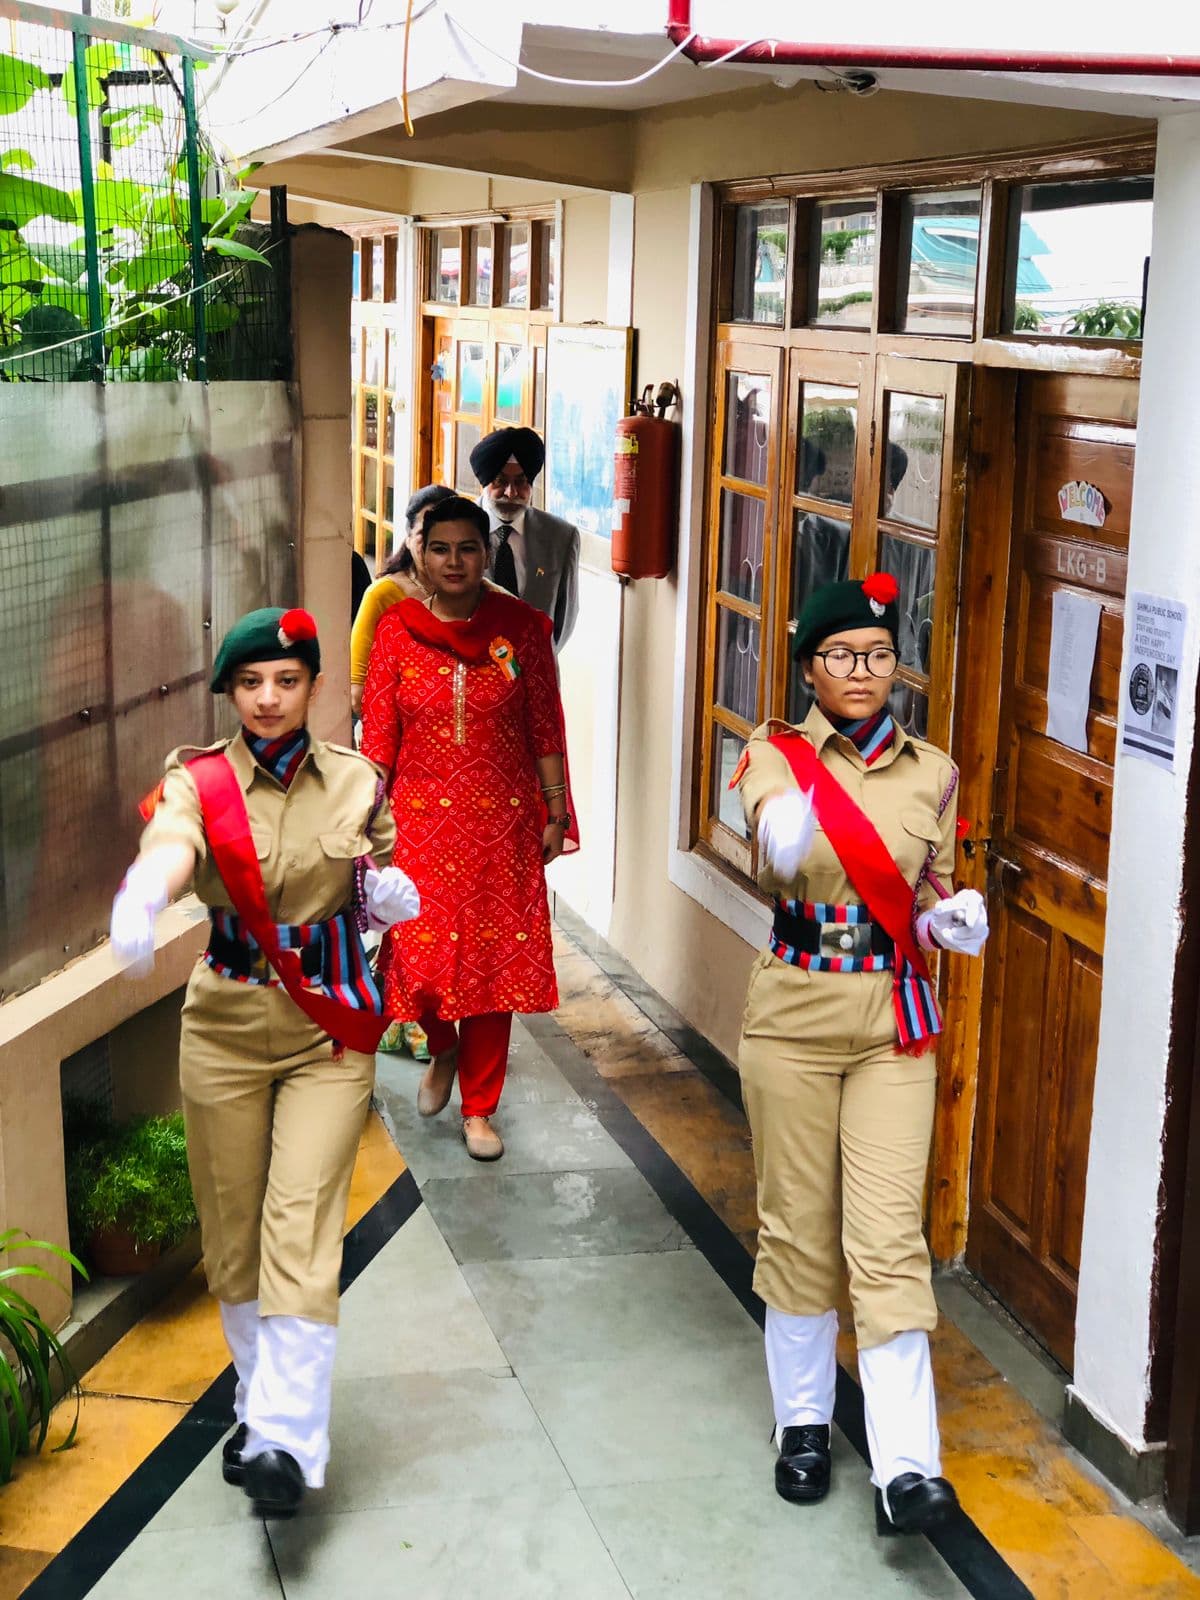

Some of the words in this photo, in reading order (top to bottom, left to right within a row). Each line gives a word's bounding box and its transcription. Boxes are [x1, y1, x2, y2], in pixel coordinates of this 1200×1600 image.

[1060, 485, 1105, 521] WELCOME
[1057, 547, 1106, 584] LKG-B
[1152, 606, 1166, 617] PUBLIC
[1167, 610, 1182, 621] SCHOOL
[1151, 639, 1165, 650] HAPPY
[1134, 645, 1166, 662] INDEPENDENCE
[1166, 653, 1176, 664] DAY
